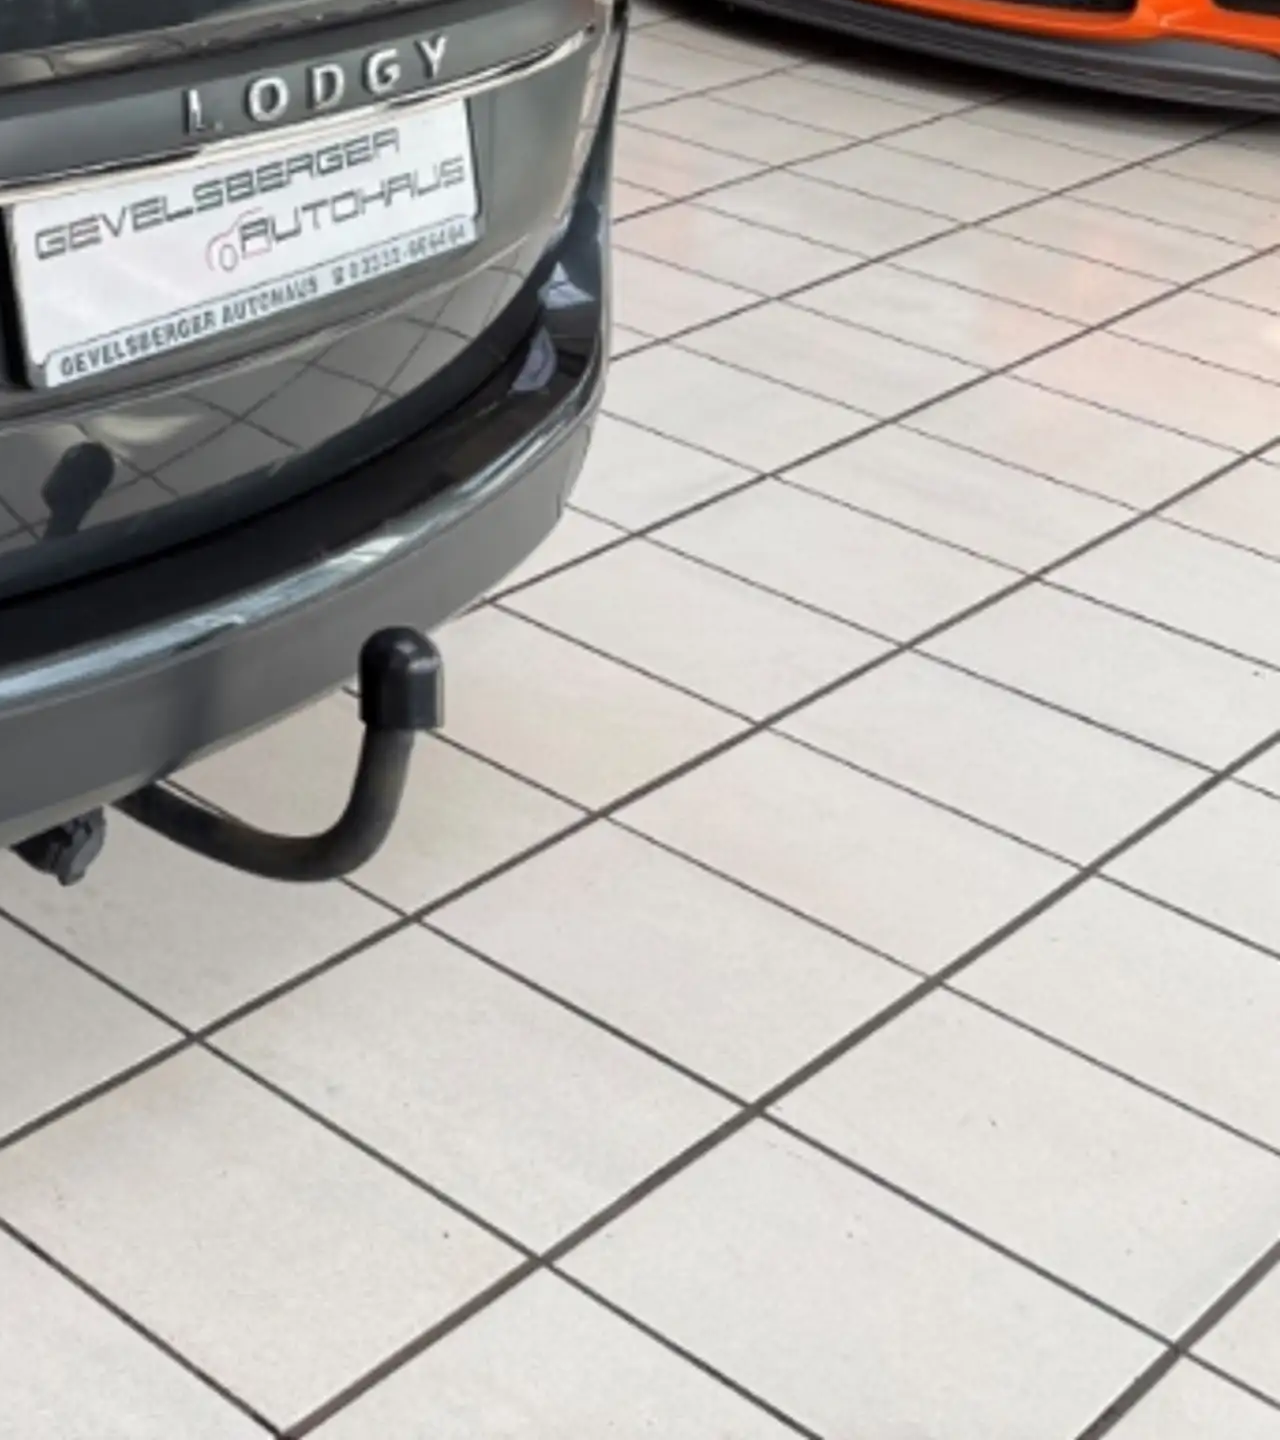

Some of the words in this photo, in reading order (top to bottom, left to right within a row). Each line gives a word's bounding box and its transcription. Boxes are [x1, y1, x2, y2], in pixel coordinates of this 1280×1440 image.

[182, 35, 447, 133] LODGY
[35, 128, 400, 259] GEVELSBERGER
[239, 156, 465, 256] AUTOHAUS
[59, 309, 217, 378] GEVELSBERGER
[221, 274, 319, 324] AUTOHAUS
